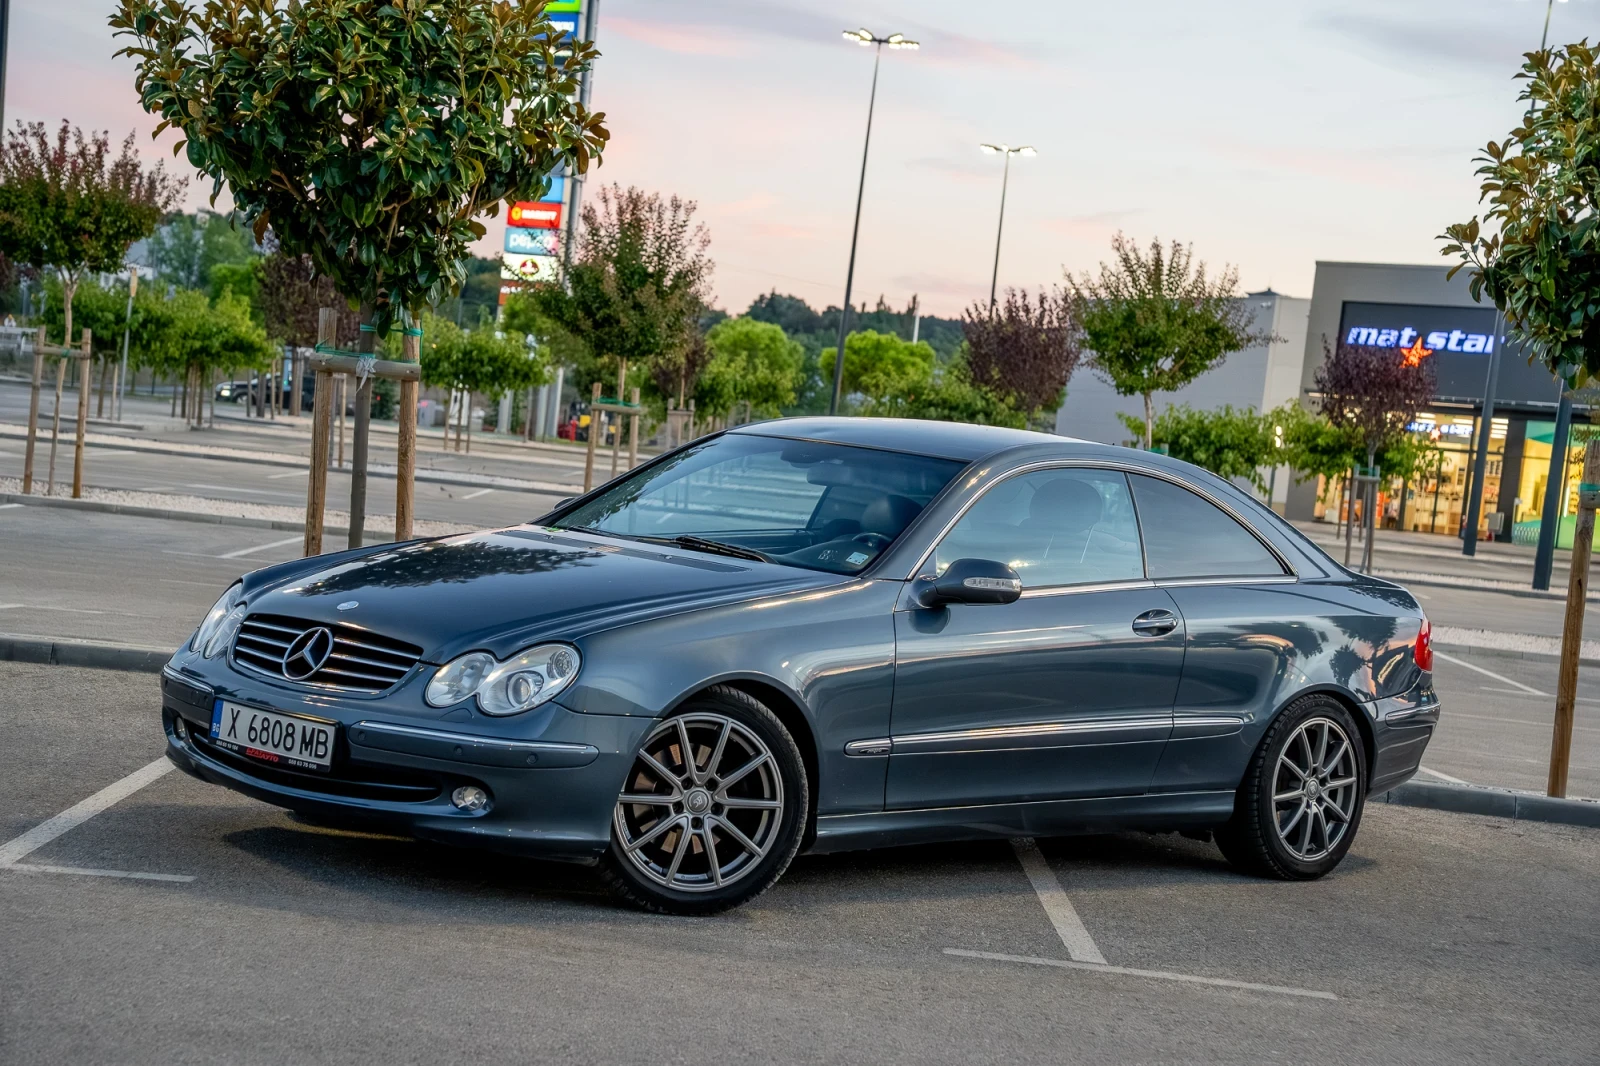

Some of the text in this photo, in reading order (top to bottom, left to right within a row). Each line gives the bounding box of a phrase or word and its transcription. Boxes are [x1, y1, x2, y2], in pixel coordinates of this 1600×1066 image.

[1346, 326, 1417, 348] mat
[212, 722, 220, 733] BG
[227, 708, 329, 759] X 6808 MB
